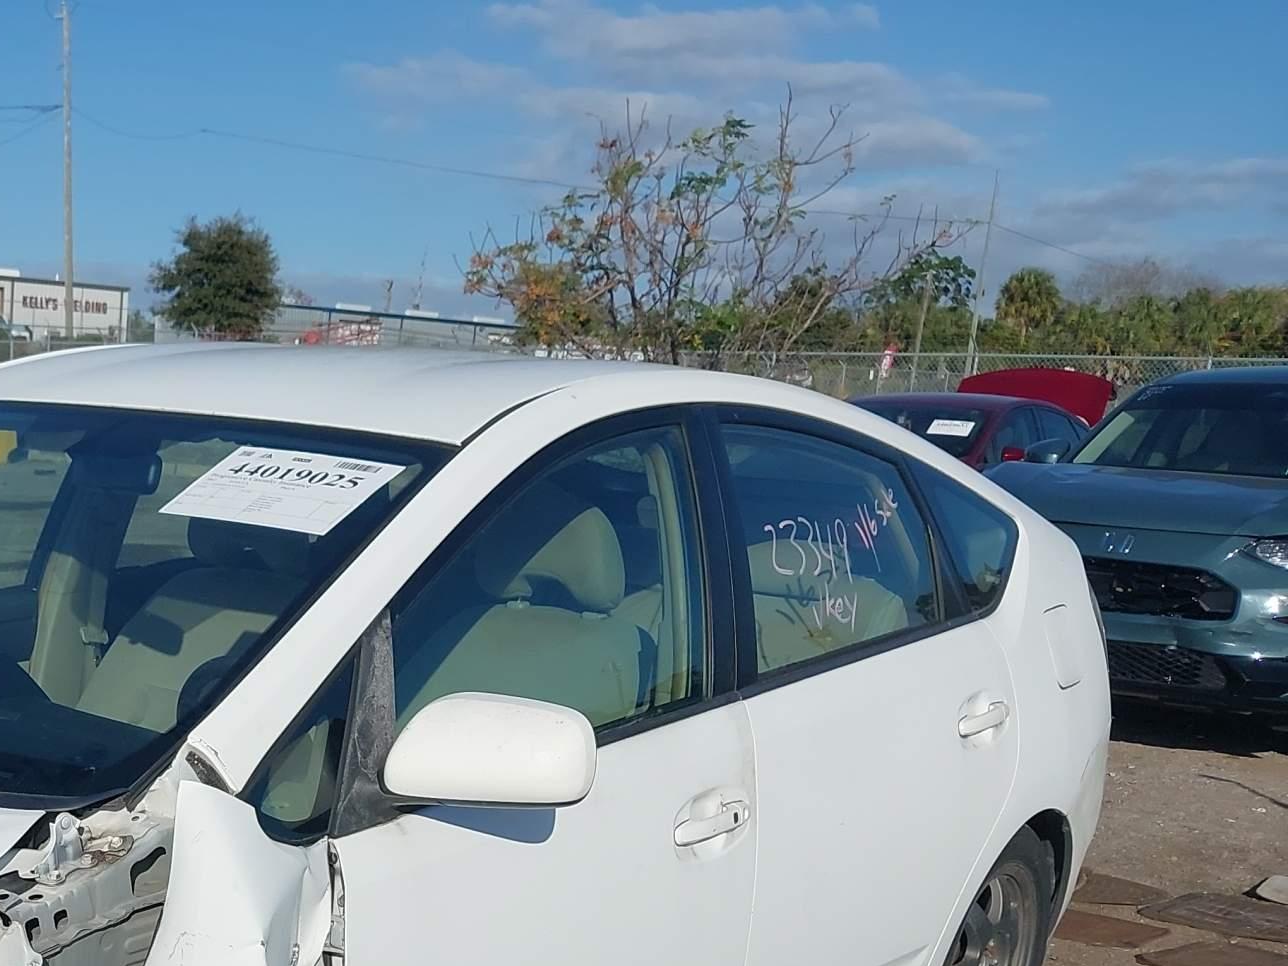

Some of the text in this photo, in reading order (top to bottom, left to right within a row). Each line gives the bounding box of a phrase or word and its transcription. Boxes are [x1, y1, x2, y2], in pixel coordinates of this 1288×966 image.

[22, 296, 107, 314] KELLY'S ELDING
[229, 461, 367, 490] 44019025
[764, 516, 853, 585] 23349
